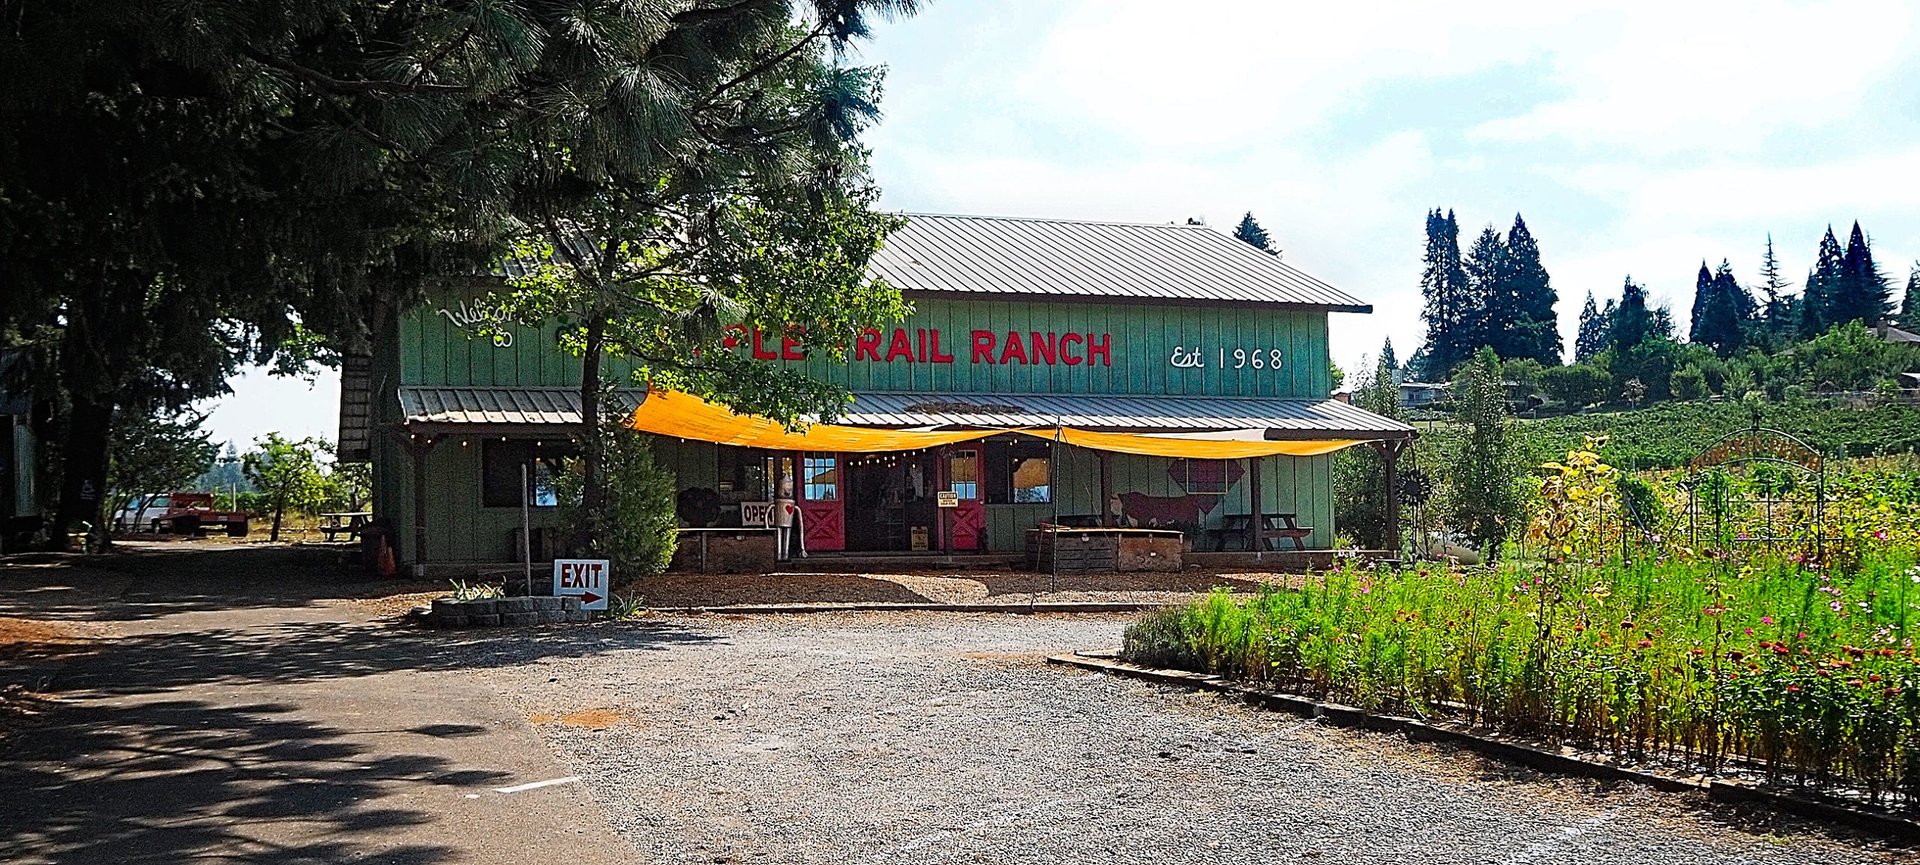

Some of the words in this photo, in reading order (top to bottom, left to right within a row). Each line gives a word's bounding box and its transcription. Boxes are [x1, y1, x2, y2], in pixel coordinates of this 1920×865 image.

[689, 323, 808, 361] PLE
[836, 325, 955, 363] RAIL
[971, 329, 1112, 367] RANCH
[1170, 346, 1205, 368] Est
[1220, 348, 1282, 369] 1968
[561, 563, 603, 588] EXIT
